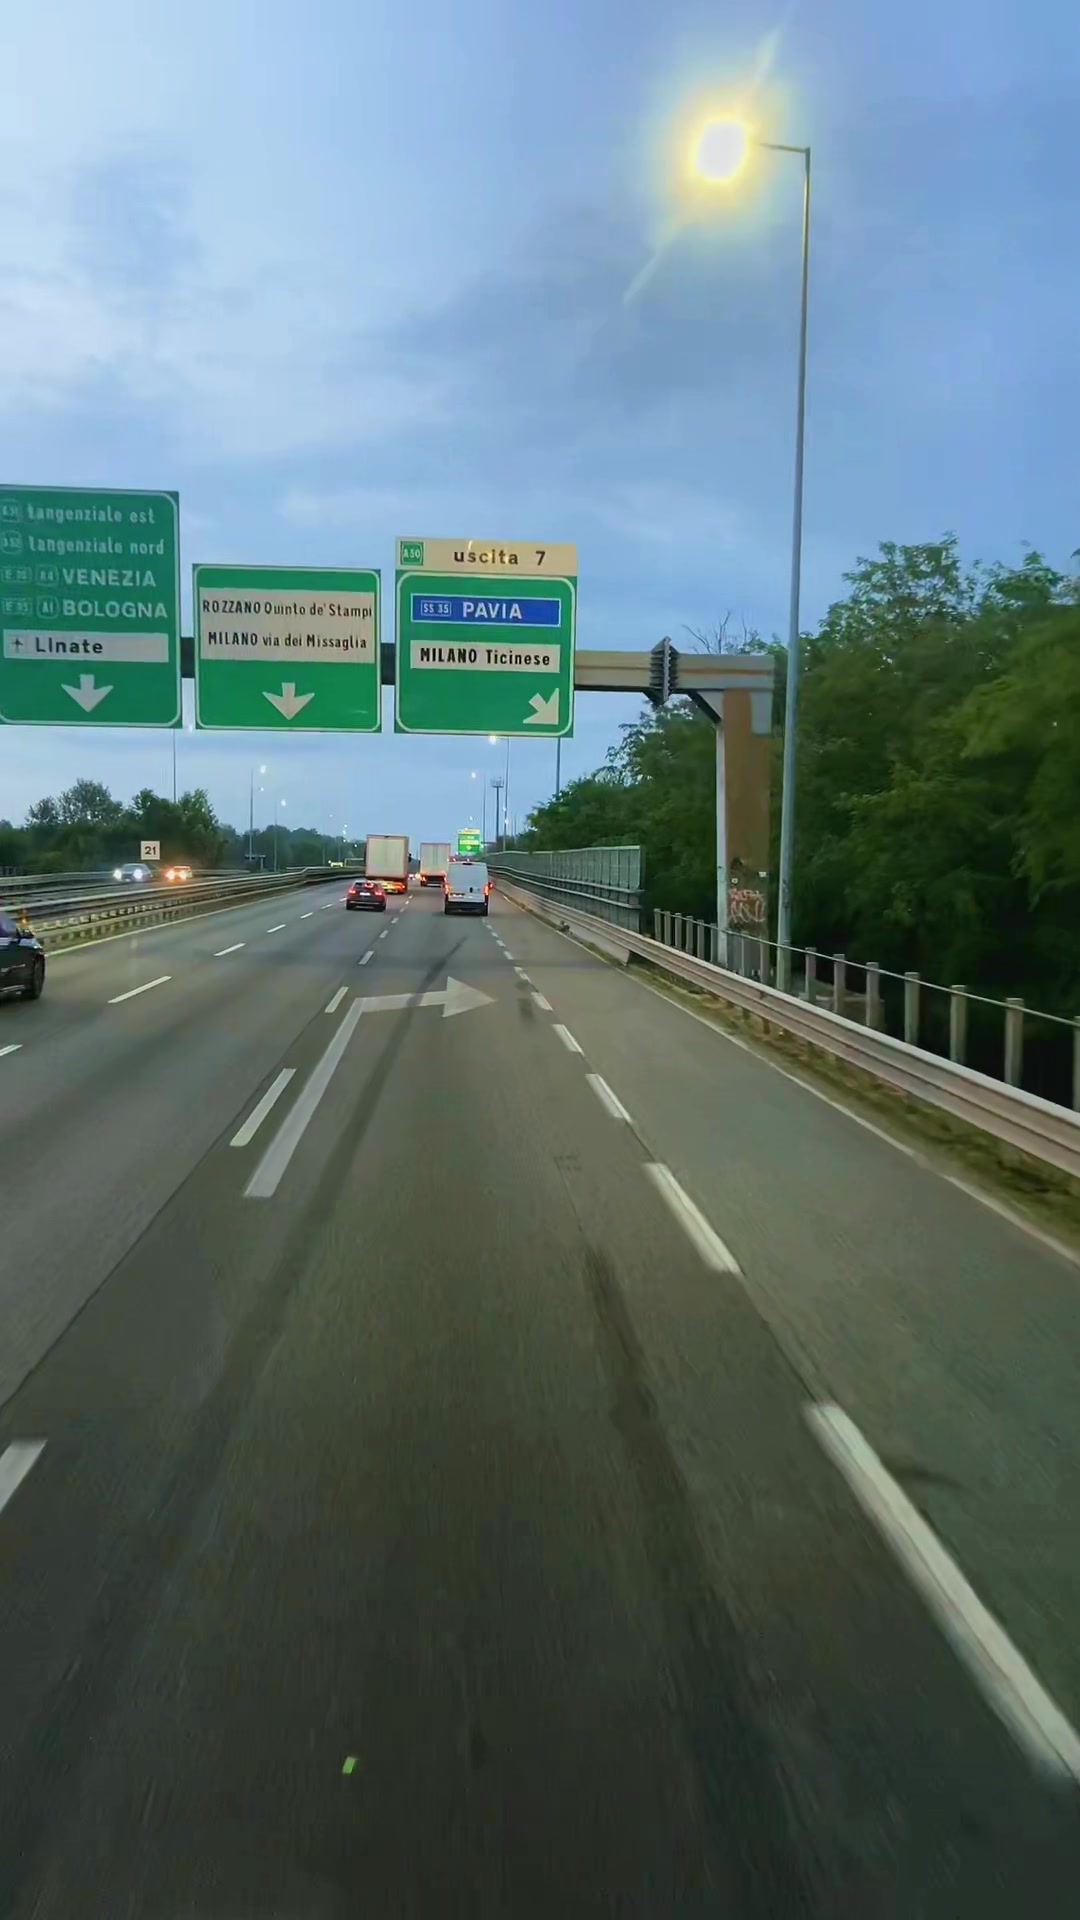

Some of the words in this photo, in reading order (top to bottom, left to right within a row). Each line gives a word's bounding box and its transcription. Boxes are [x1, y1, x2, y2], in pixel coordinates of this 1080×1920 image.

[27, 504, 122, 523] tangenziale
[129, 507, 155, 524] est
[29, 535, 123, 555] tangenziale
[130, 538, 164, 555] nord
[453, 549, 519, 565] uscita
[535, 550, 546, 566] 7
[62, 567, 156, 587] VENEZIA
[62, 599, 168, 619] BOLOGNA
[202, 599, 261, 614] ROZZANO
[264, 601, 306, 616] Quinto
[329, 603, 372, 620] Stampi
[422, 603, 435, 613] SS
[437, 603, 449, 614] 35
[462, 601, 522, 620] PAVIA
[35, 636, 104, 654] Linate
[208, 631, 258, 646] MILANO
[262, 633, 280, 647] via
[284, 633, 303, 647] dei
[306, 634, 367, 651] Missaglia
[420, 647, 477, 664] MILANO
[485, 649, 550, 666] Ticinese
[144, 845, 156, 855] 21
